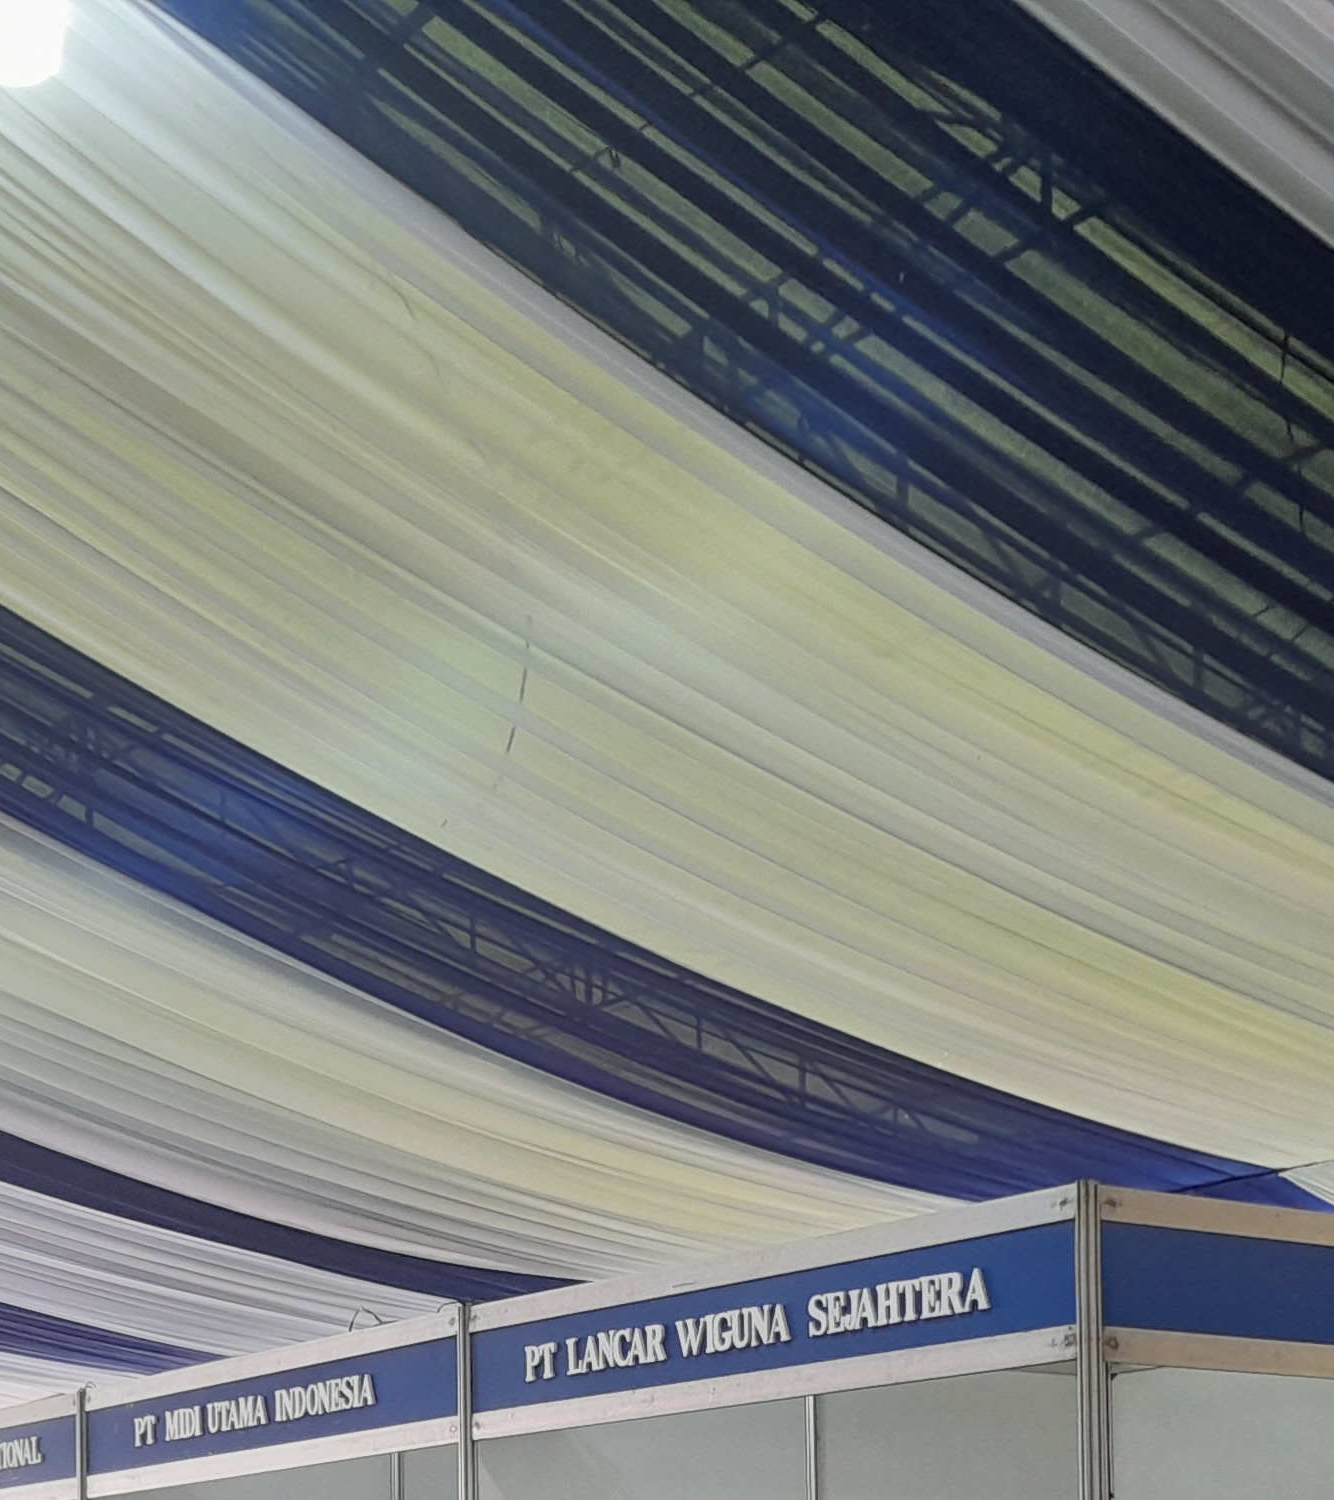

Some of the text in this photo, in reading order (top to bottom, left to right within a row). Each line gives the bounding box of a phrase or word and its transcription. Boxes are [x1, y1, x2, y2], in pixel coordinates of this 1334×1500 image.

[524, 1267, 991, 1383] PT LANCAR WIGUNA SEJAHTERA
[133, 1373, 377, 1447] PT MIDI UTAMA INDONESIA
